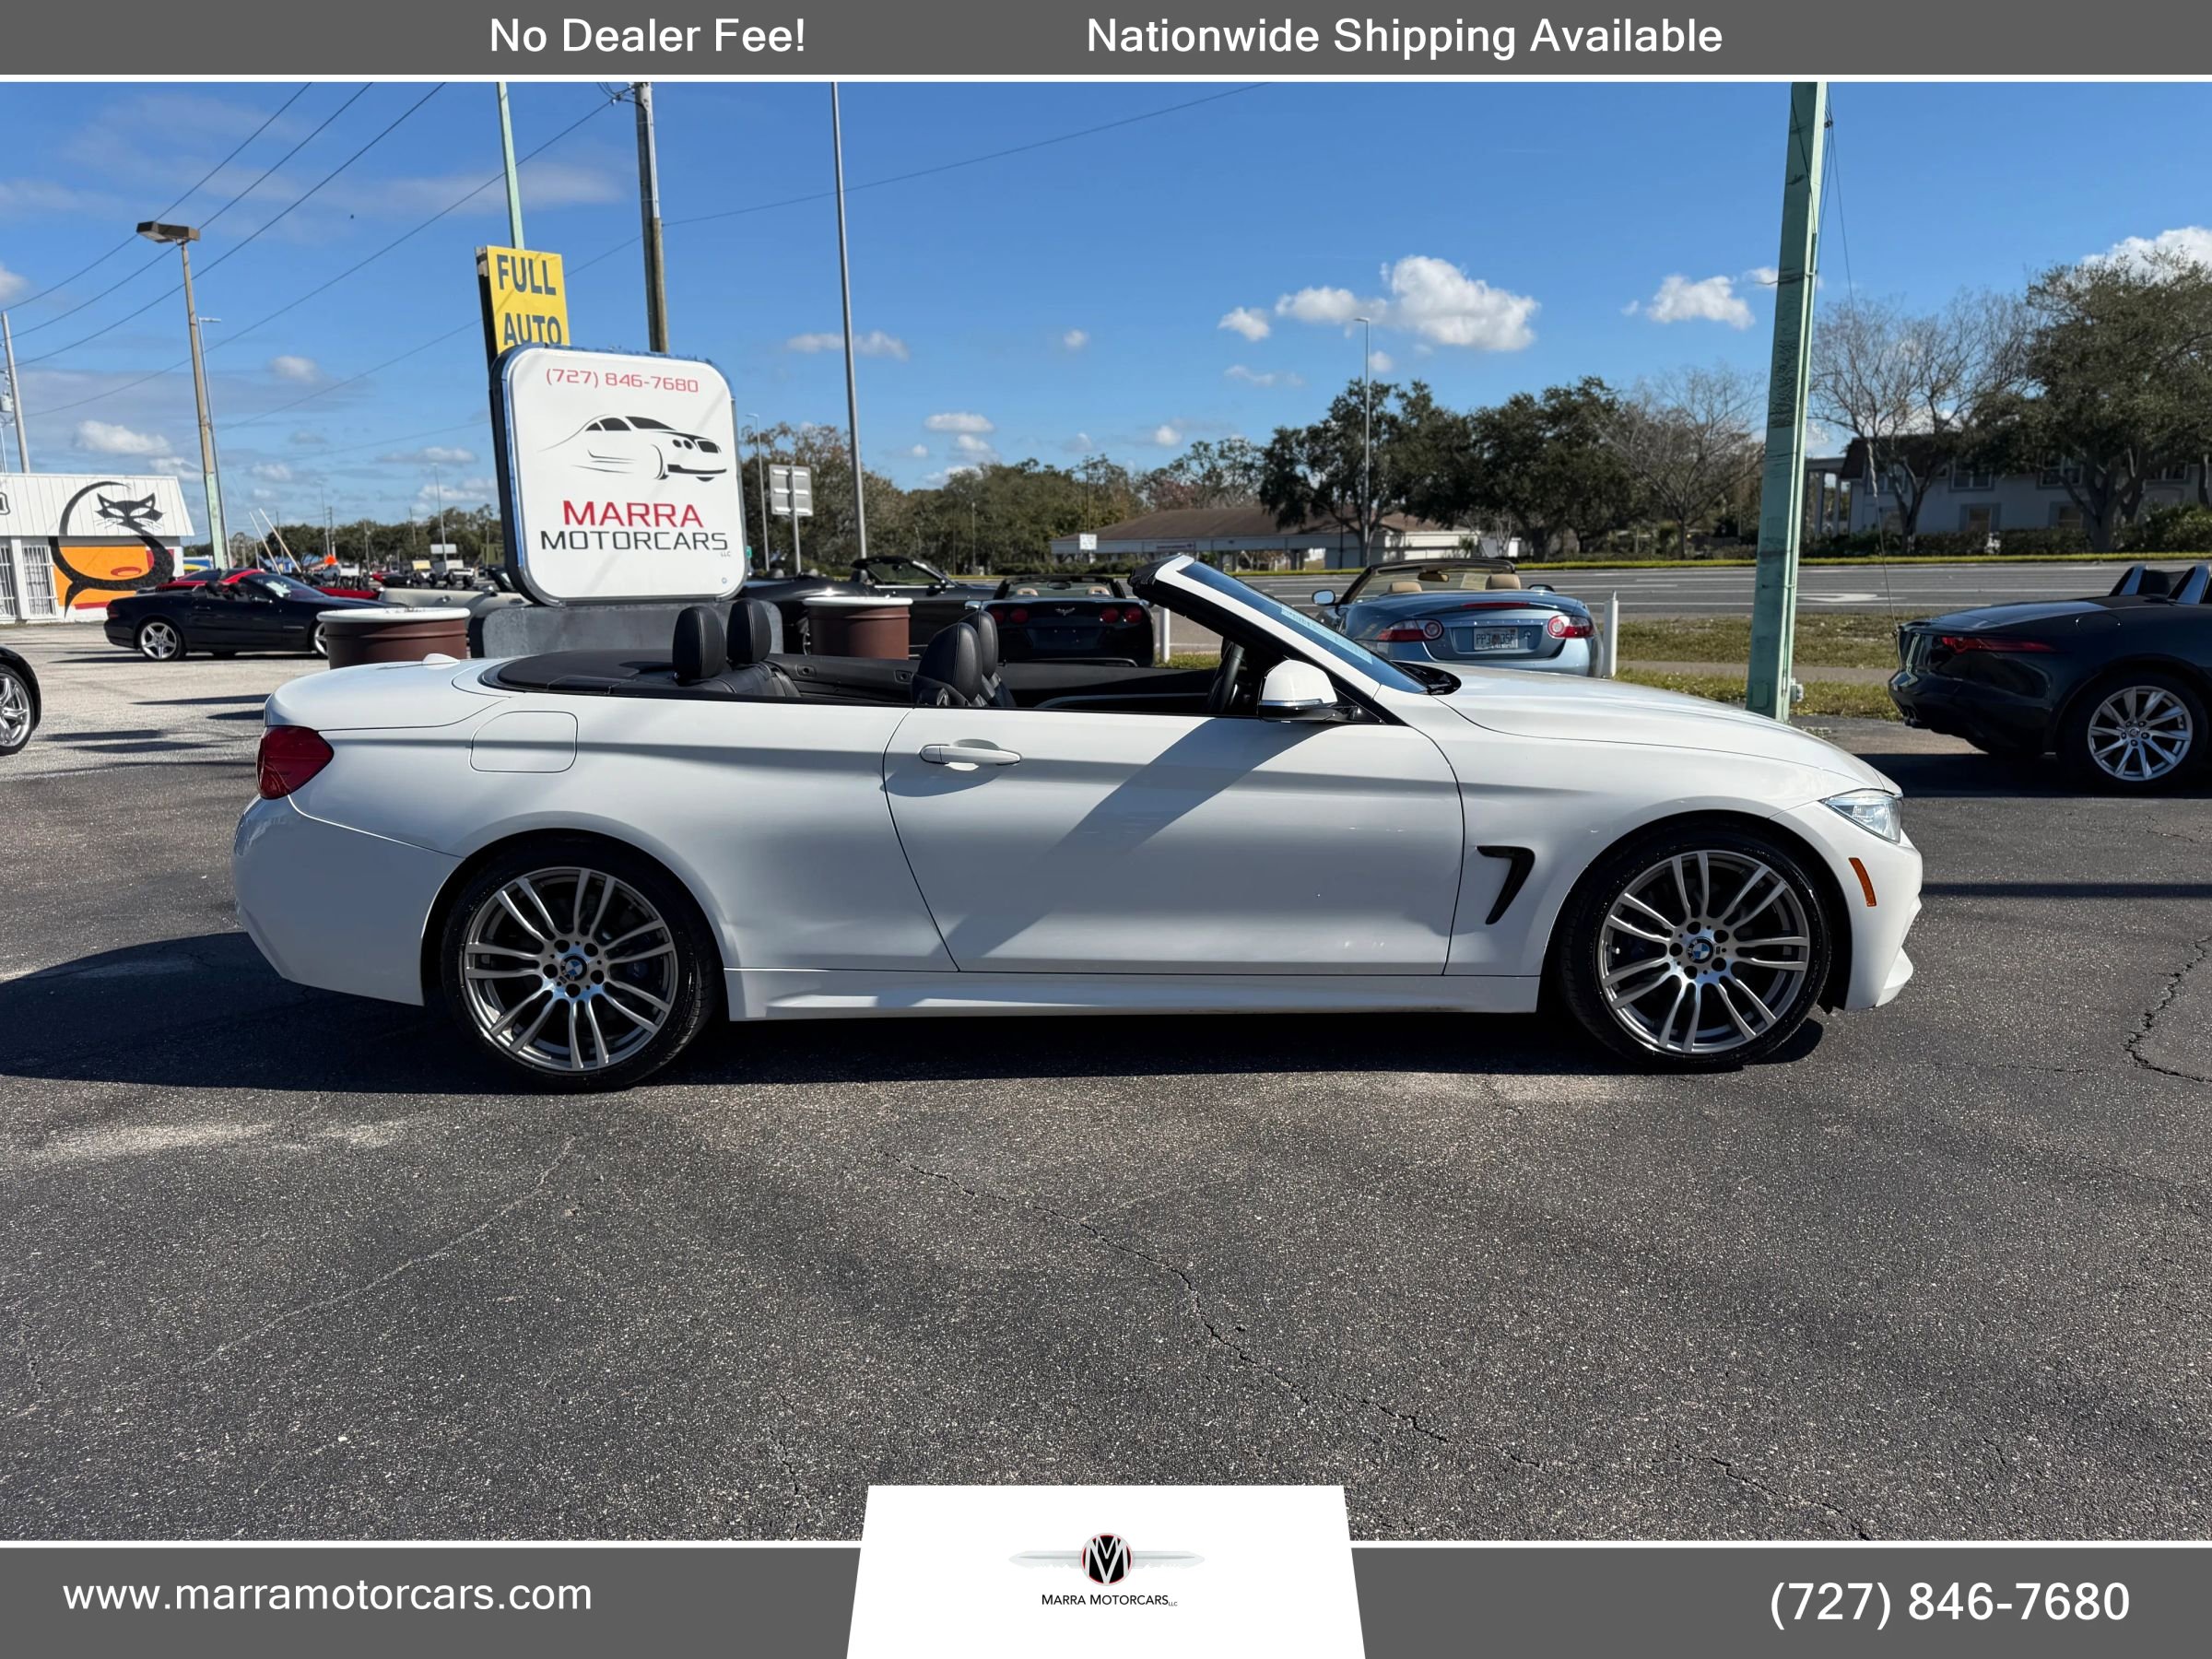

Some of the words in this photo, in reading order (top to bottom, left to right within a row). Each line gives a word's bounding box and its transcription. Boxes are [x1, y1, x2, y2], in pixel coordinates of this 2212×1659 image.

[496, 253, 557, 296] FULL
[503, 312, 562, 346] AUTO
[546, 368, 599, 389] (727)
[605, 372, 700, 394] 846-7680
[562, 500, 704, 528] MARRA
[540, 530, 728, 551] MOTORCARS
